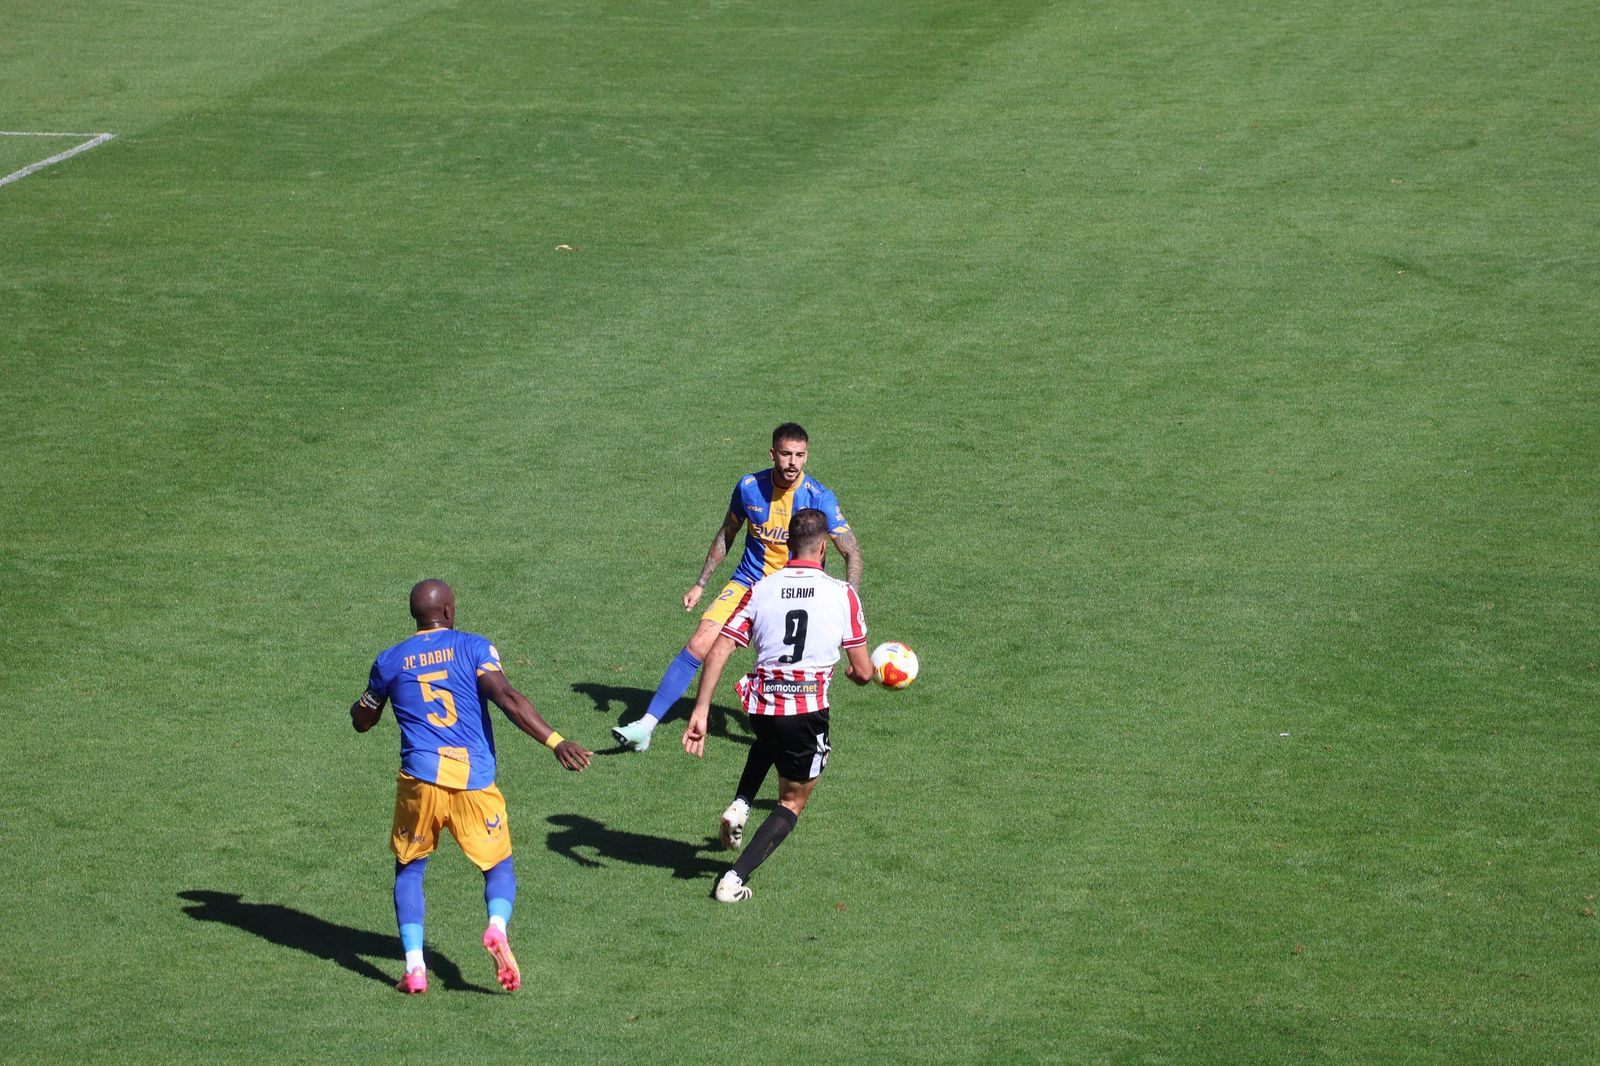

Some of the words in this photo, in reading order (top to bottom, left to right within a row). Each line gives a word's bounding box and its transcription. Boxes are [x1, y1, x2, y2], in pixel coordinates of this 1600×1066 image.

[781, 587, 815, 599] ESLAVA
[778, 609, 808, 664] 9
[402, 655, 417, 670] JC
[419, 647, 454, 667] BABIN
[417, 669, 458, 728] 5
[763, 682, 818, 693] leomotor.net
